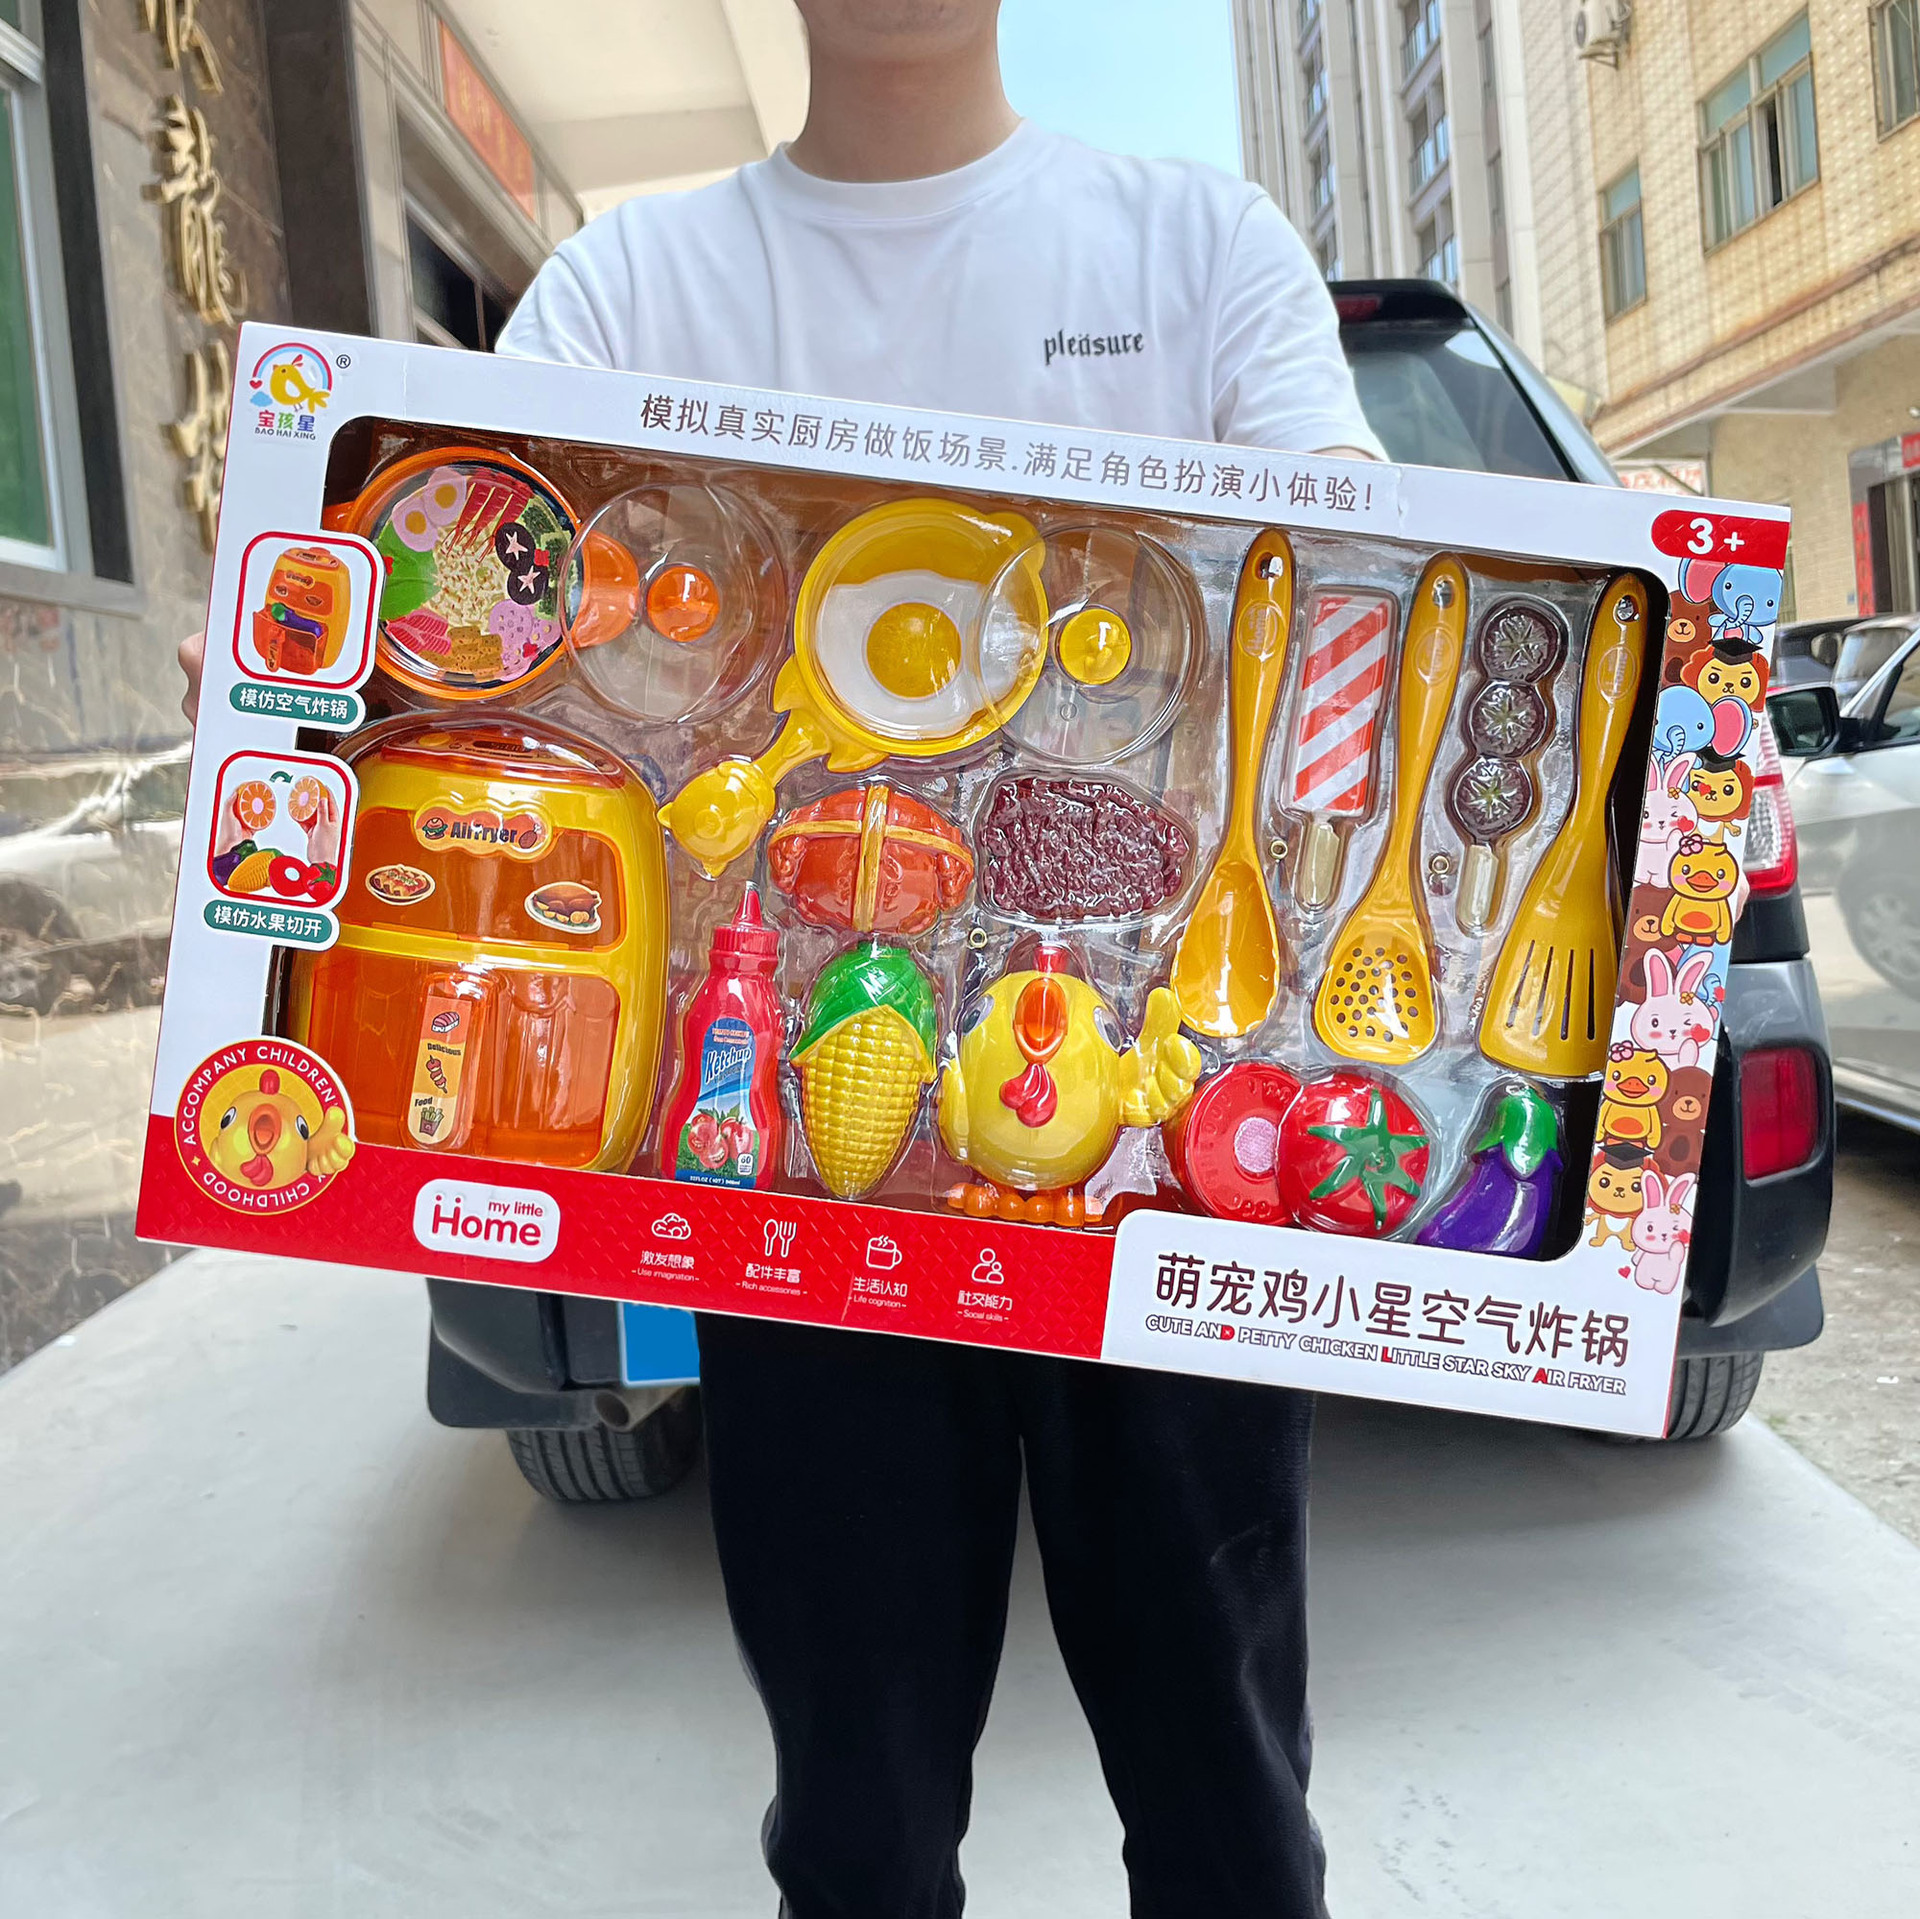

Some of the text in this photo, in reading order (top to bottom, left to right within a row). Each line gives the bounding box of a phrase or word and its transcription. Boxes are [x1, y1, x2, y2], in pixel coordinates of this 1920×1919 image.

[254, 427, 316, 440] BAO HAI XING
[258, 409, 315, 432] 宝孩星
[239, 687, 348, 719] 模仿空气炸锅
[213, 904, 323, 938] 模仿水果切开
[705, 1046, 752, 1085] Ketchup
[182, 1048, 247, 1146] ACCOMPANY
[414, 1096, 433, 1107] Food
[203, 1172, 310, 1208] CHILDHOOD
[432, 1194, 541, 1246] Home
[488, 1201, 544, 1218] my little
[640, 1250, 695, 1270] 激发想象
[745, 1263, 801, 1284] 配件丰富
[853, 1276, 908, 1297] 生活认知
[957, 1290, 1013, 1311] 社交能力
[1156, 1252, 1629, 1368] 萌宠鸡小星空气炸锅
[1145, 1315, 1627, 1395] CUTE AND PETTY CHICKEN LITTLE STAR SKY AIR FRYER
